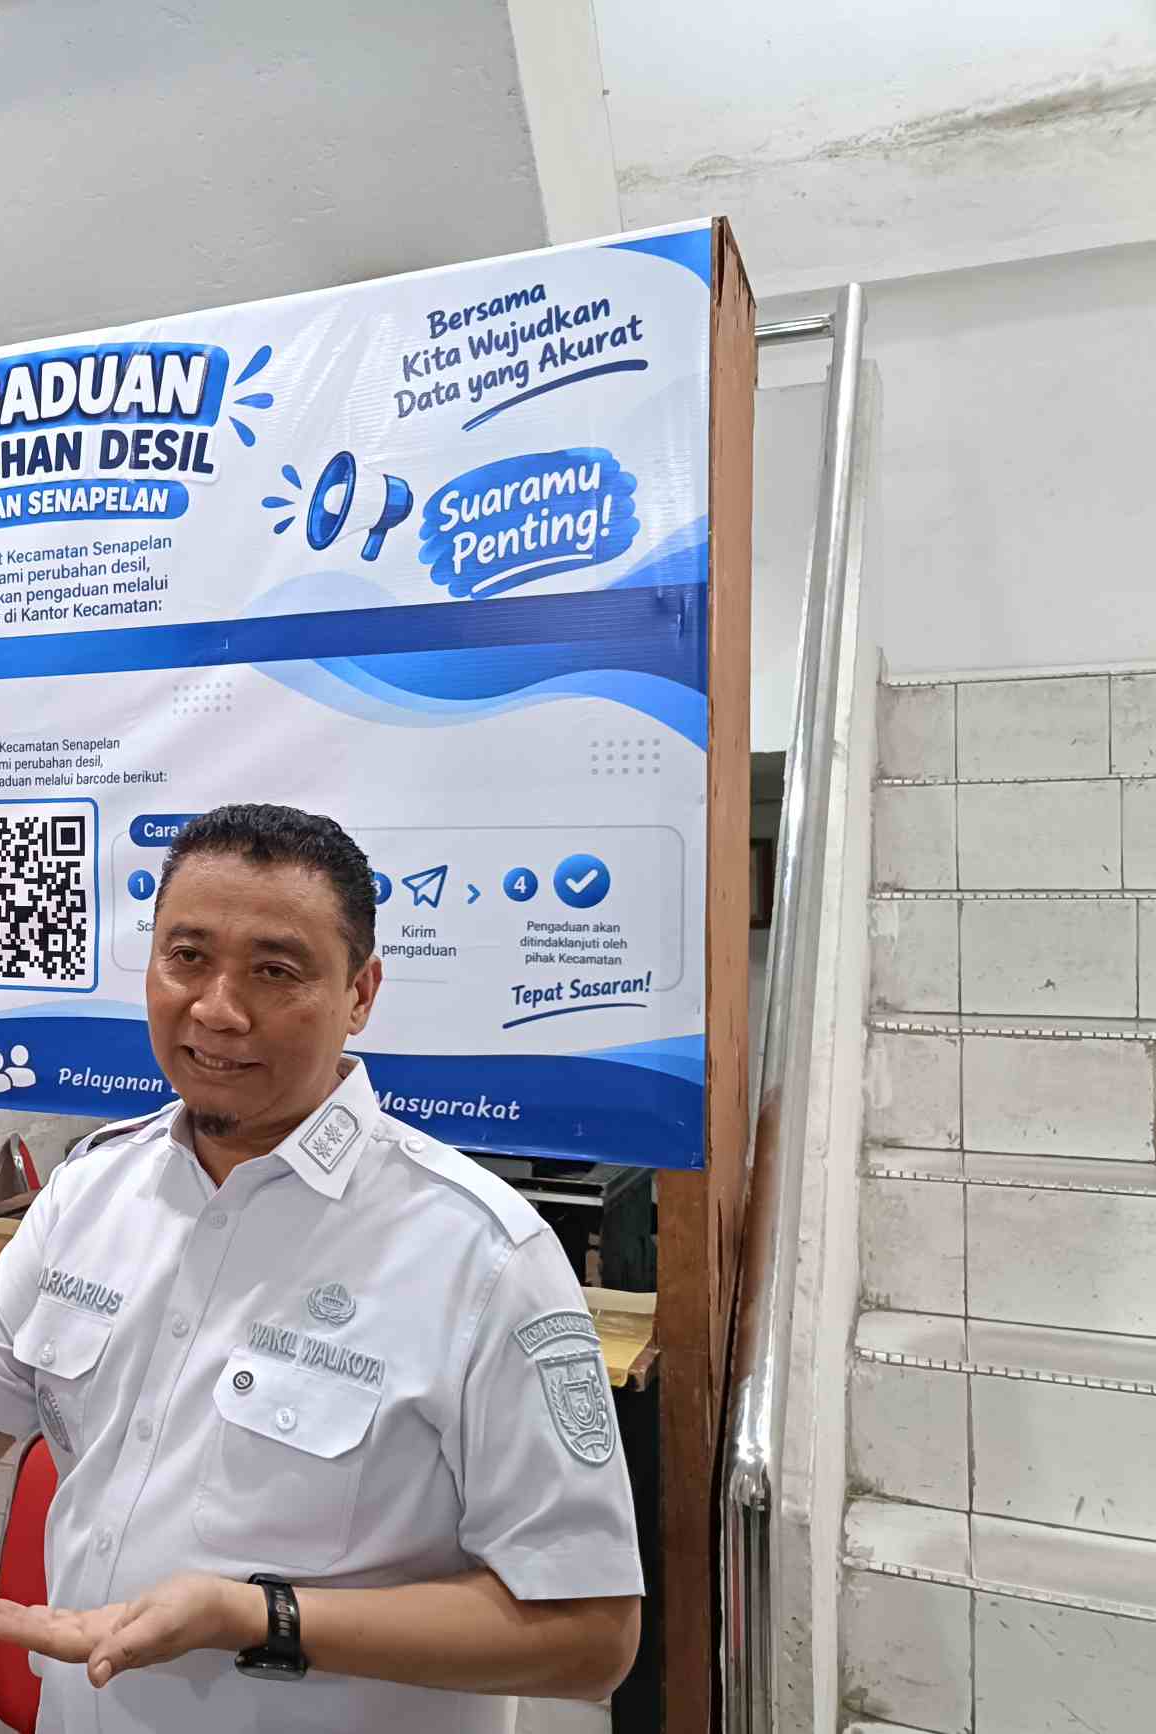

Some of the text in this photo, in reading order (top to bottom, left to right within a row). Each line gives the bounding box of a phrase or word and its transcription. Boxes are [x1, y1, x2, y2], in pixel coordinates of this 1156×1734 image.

[427, 284, 546, 338] Bersama
[402, 297, 610, 382] Kita Wujudkan
[394, 315, 643, 418] Data yang Akurat
[99, 429, 214, 474] DESIL
[28, 488, 169, 516] SENAPELAN
[439, 462, 612, 574] Suaramu Penting!
[7, 544, 88, 564] Kecamatan
[92, 535, 172, 557] Senapelan
[28, 561, 107, 584] perubahan
[111, 556, 151, 575] desil,
[26, 581, 108, 604] pengaduan
[113, 575, 168, 594] melalui
[4, 608, 17, 623] di
[21, 604, 68, 622] Kantor
[73, 599, 162, 617] Kecamatan:
[0, 740, 59, 754] Kecamatan
[62, 737, 120, 752] Senapelan
[15, 757, 72, 771] perubahan
[75, 755, 104, 769] desil,
[35, 772, 73, 786] melalui
[76, 771, 120, 785] barcode
[123, 770, 168, 784] berikut:
[144, 822, 179, 838] Cara
[137, 876, 145, 893] 1
[513, 876, 526, 894] 4
[401, 924, 436, 939] Kirim
[526, 920, 620, 934] Pengaduan akan
[382, 942, 457, 959] pengaduan
[520, 936, 628, 950] ditindaklanjuti oleh
[525, 951, 622, 966] pihak Kecamatan
[511, 970, 652, 1009] Tepat Sasaran!
[58, 1067, 163, 1094] Pelayanan
[374, 1090, 520, 1120] Masyarakat
